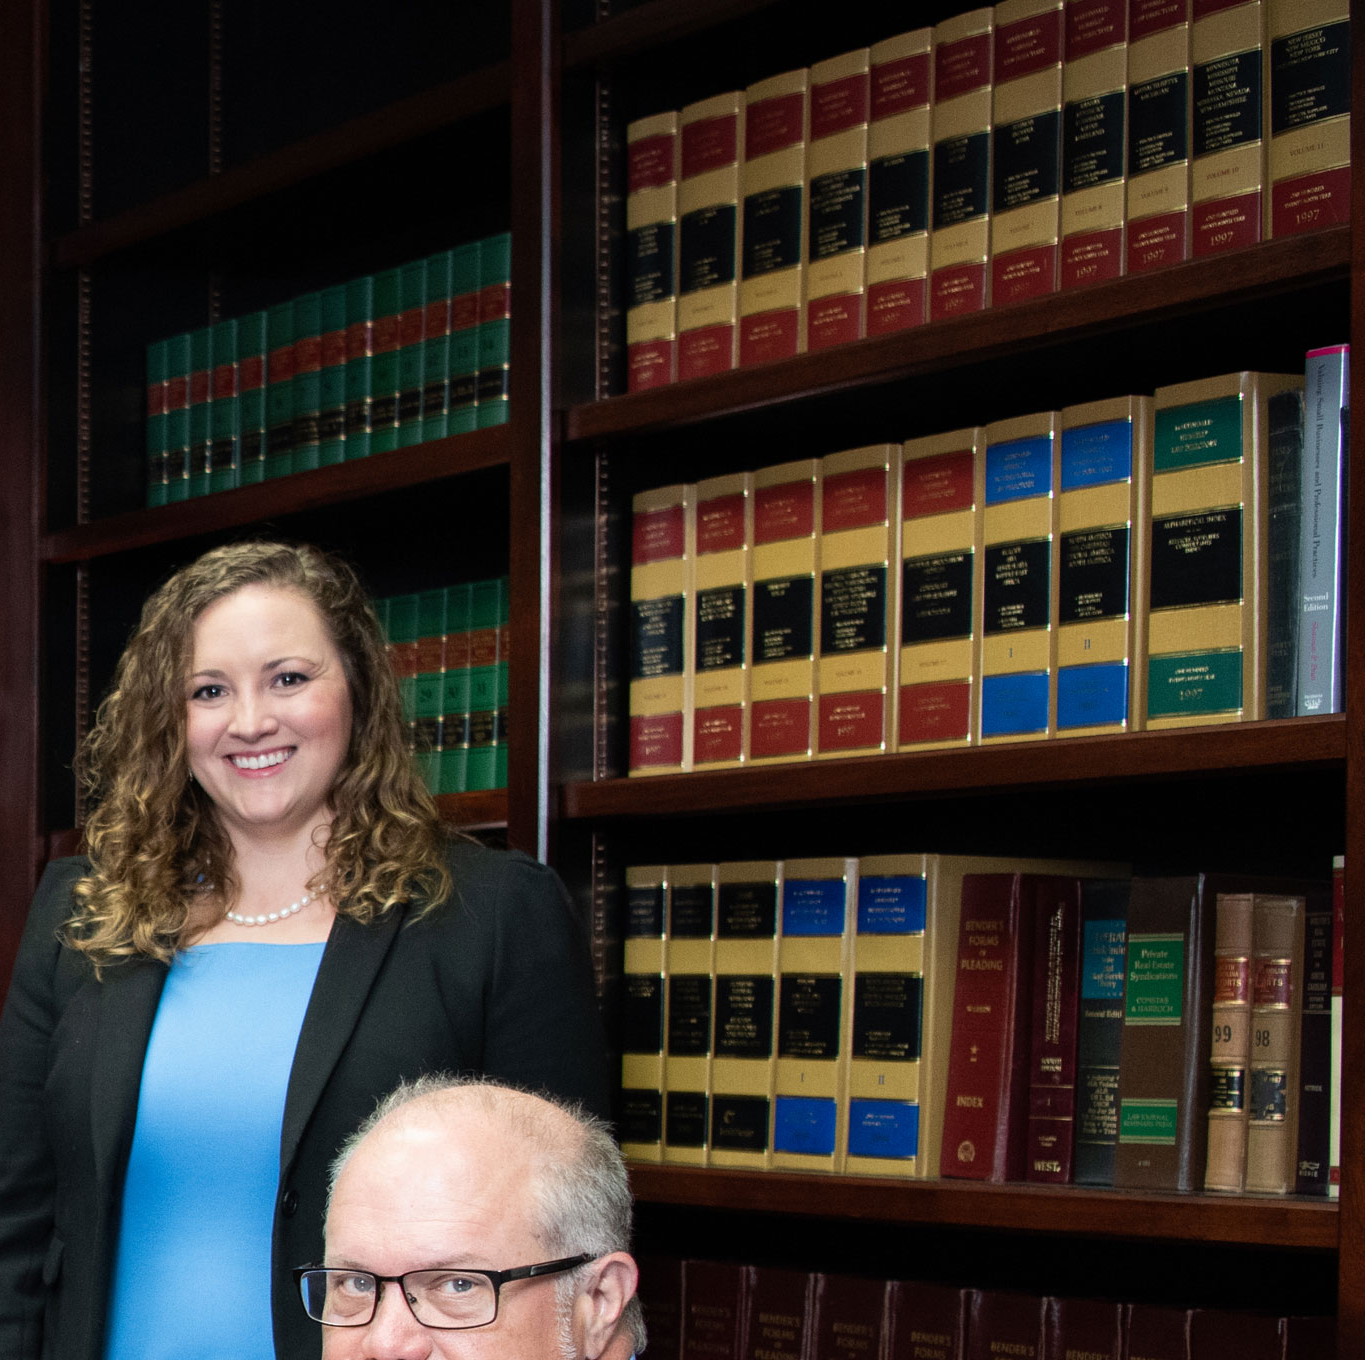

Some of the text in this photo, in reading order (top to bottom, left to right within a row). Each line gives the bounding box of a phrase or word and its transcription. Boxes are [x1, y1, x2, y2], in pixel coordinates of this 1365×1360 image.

[1296, 208, 1321, 225] 1997
[1210, 231, 1235, 247] 1997
[1315, 363, 1326, 395] Valuing
[1316, 398, 1325, 421] Small
[1314, 424, 1324, 469] Businesses
[1312, 489, 1323, 538] Professional
[1311, 540, 1321, 579] Practices
[1303, 591, 1329, 603] Second
[1303, 602, 1329, 613] Edition
[969, 936, 1000, 948] FORMS
[1141, 948, 1169, 960] Private
[961, 959, 1005, 972] PLEADING
[1134, 960, 1174, 970] Real Estate
[1130, 971, 1178, 983] Syndications
[1214, 1026, 1232, 1042] 99
[1256, 1030, 1270, 1047] 98
[956, 1096, 984, 1109] INDEX
[910, 1330, 952, 1347] BENDER'S
[913, 1346, 947, 1360] FORMS
[990, 1341, 1036, 1358] BENDER'S
